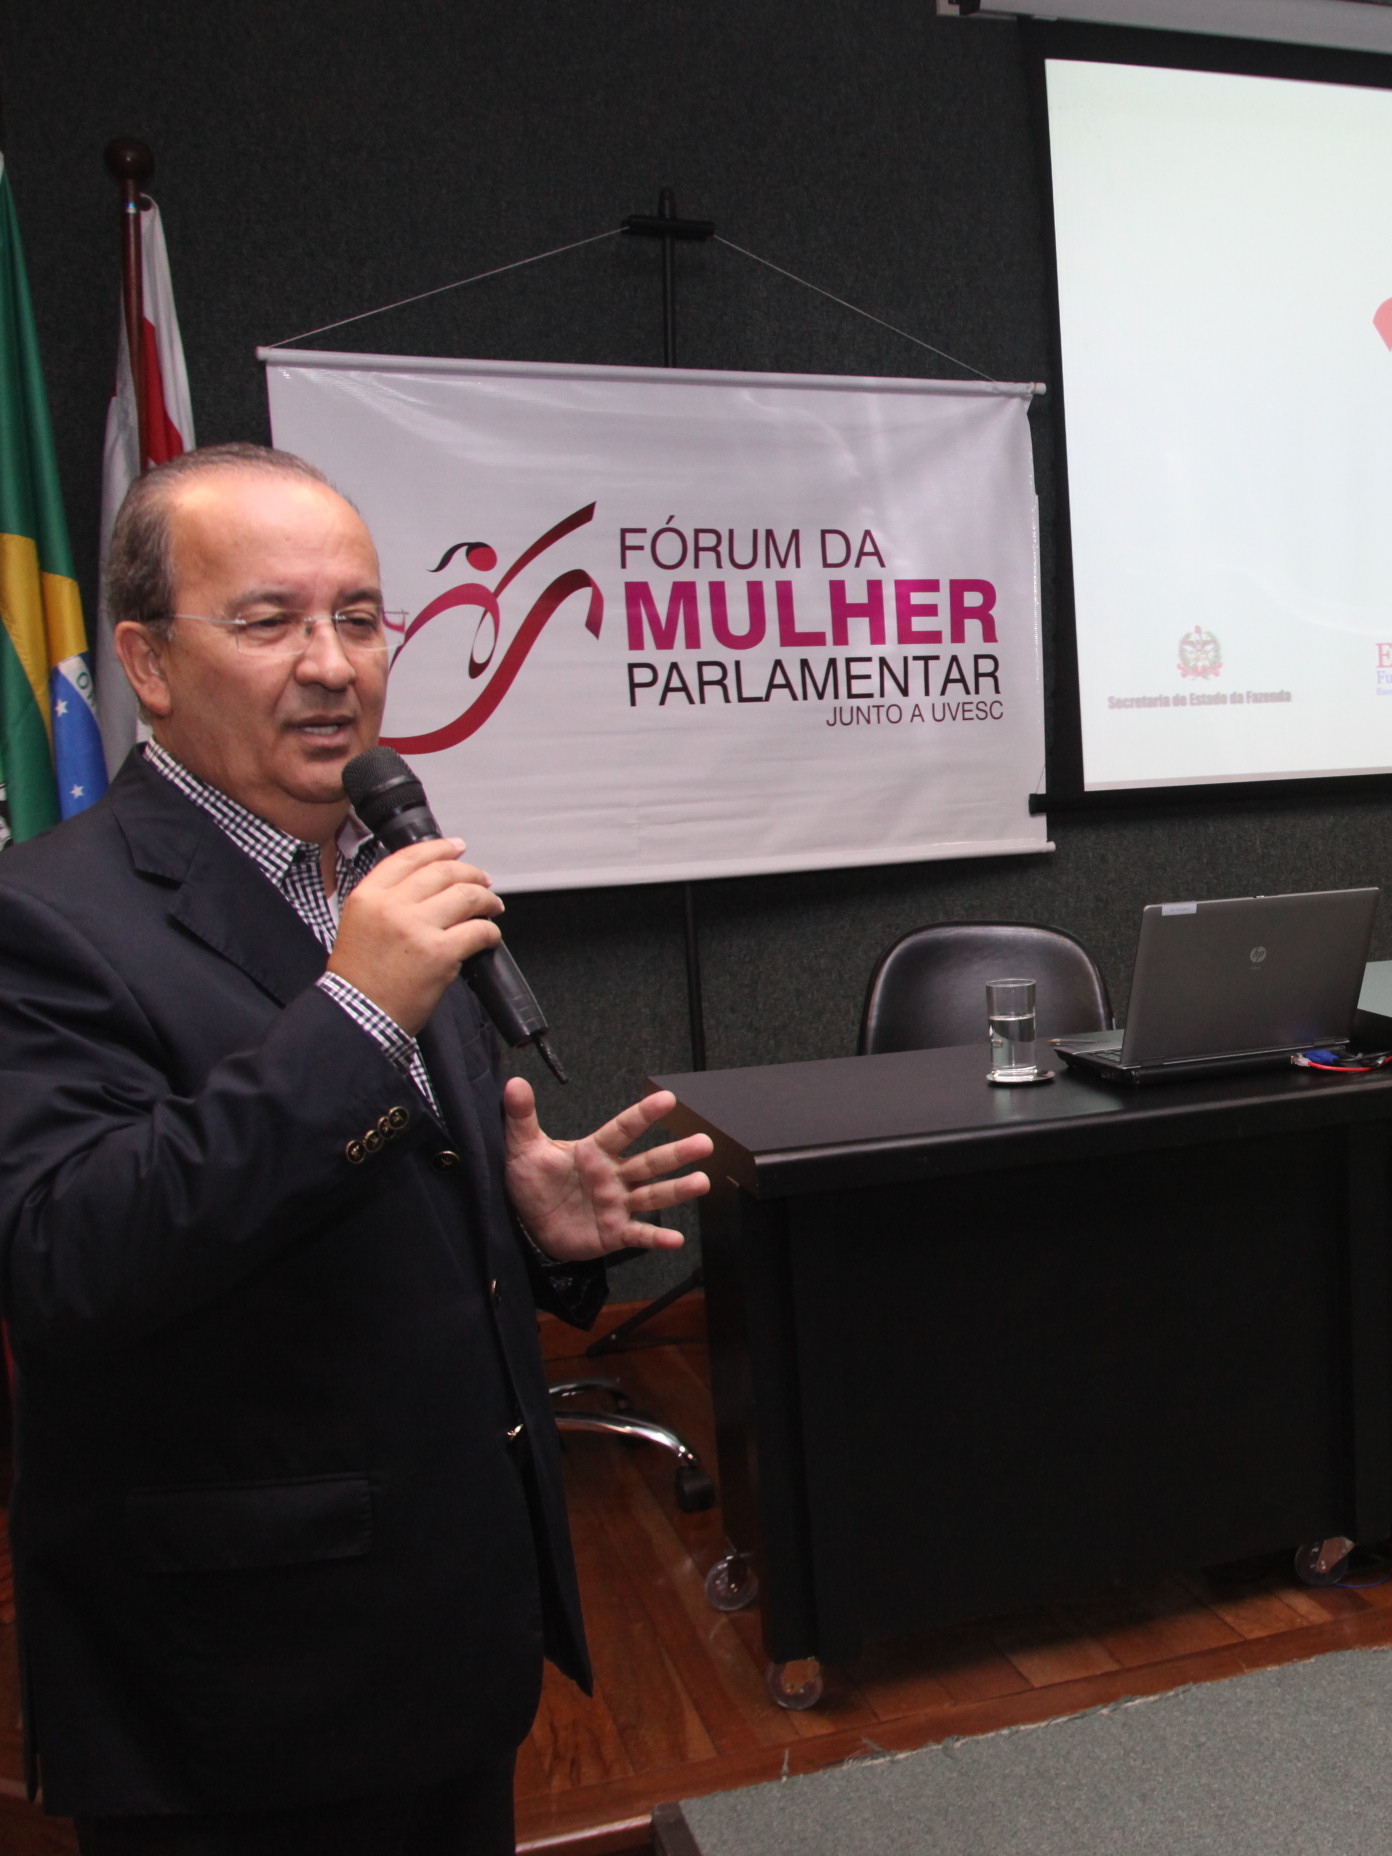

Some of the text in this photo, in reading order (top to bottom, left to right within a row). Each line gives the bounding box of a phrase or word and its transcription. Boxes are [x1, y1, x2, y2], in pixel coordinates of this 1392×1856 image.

[619, 515, 886, 570] FÓRUM DA
[624, 578, 999, 651] MULHER
[627, 653, 1001, 707] PARLAMENTAR
[1107, 694, 1171, 710] Secretaria
[1189, 691, 1228, 706] Estado
[1229, 691, 1244, 705] da
[1246, 689, 1292, 704] Fazenda
[826, 700, 1004, 727] JUNTO A UVESC
